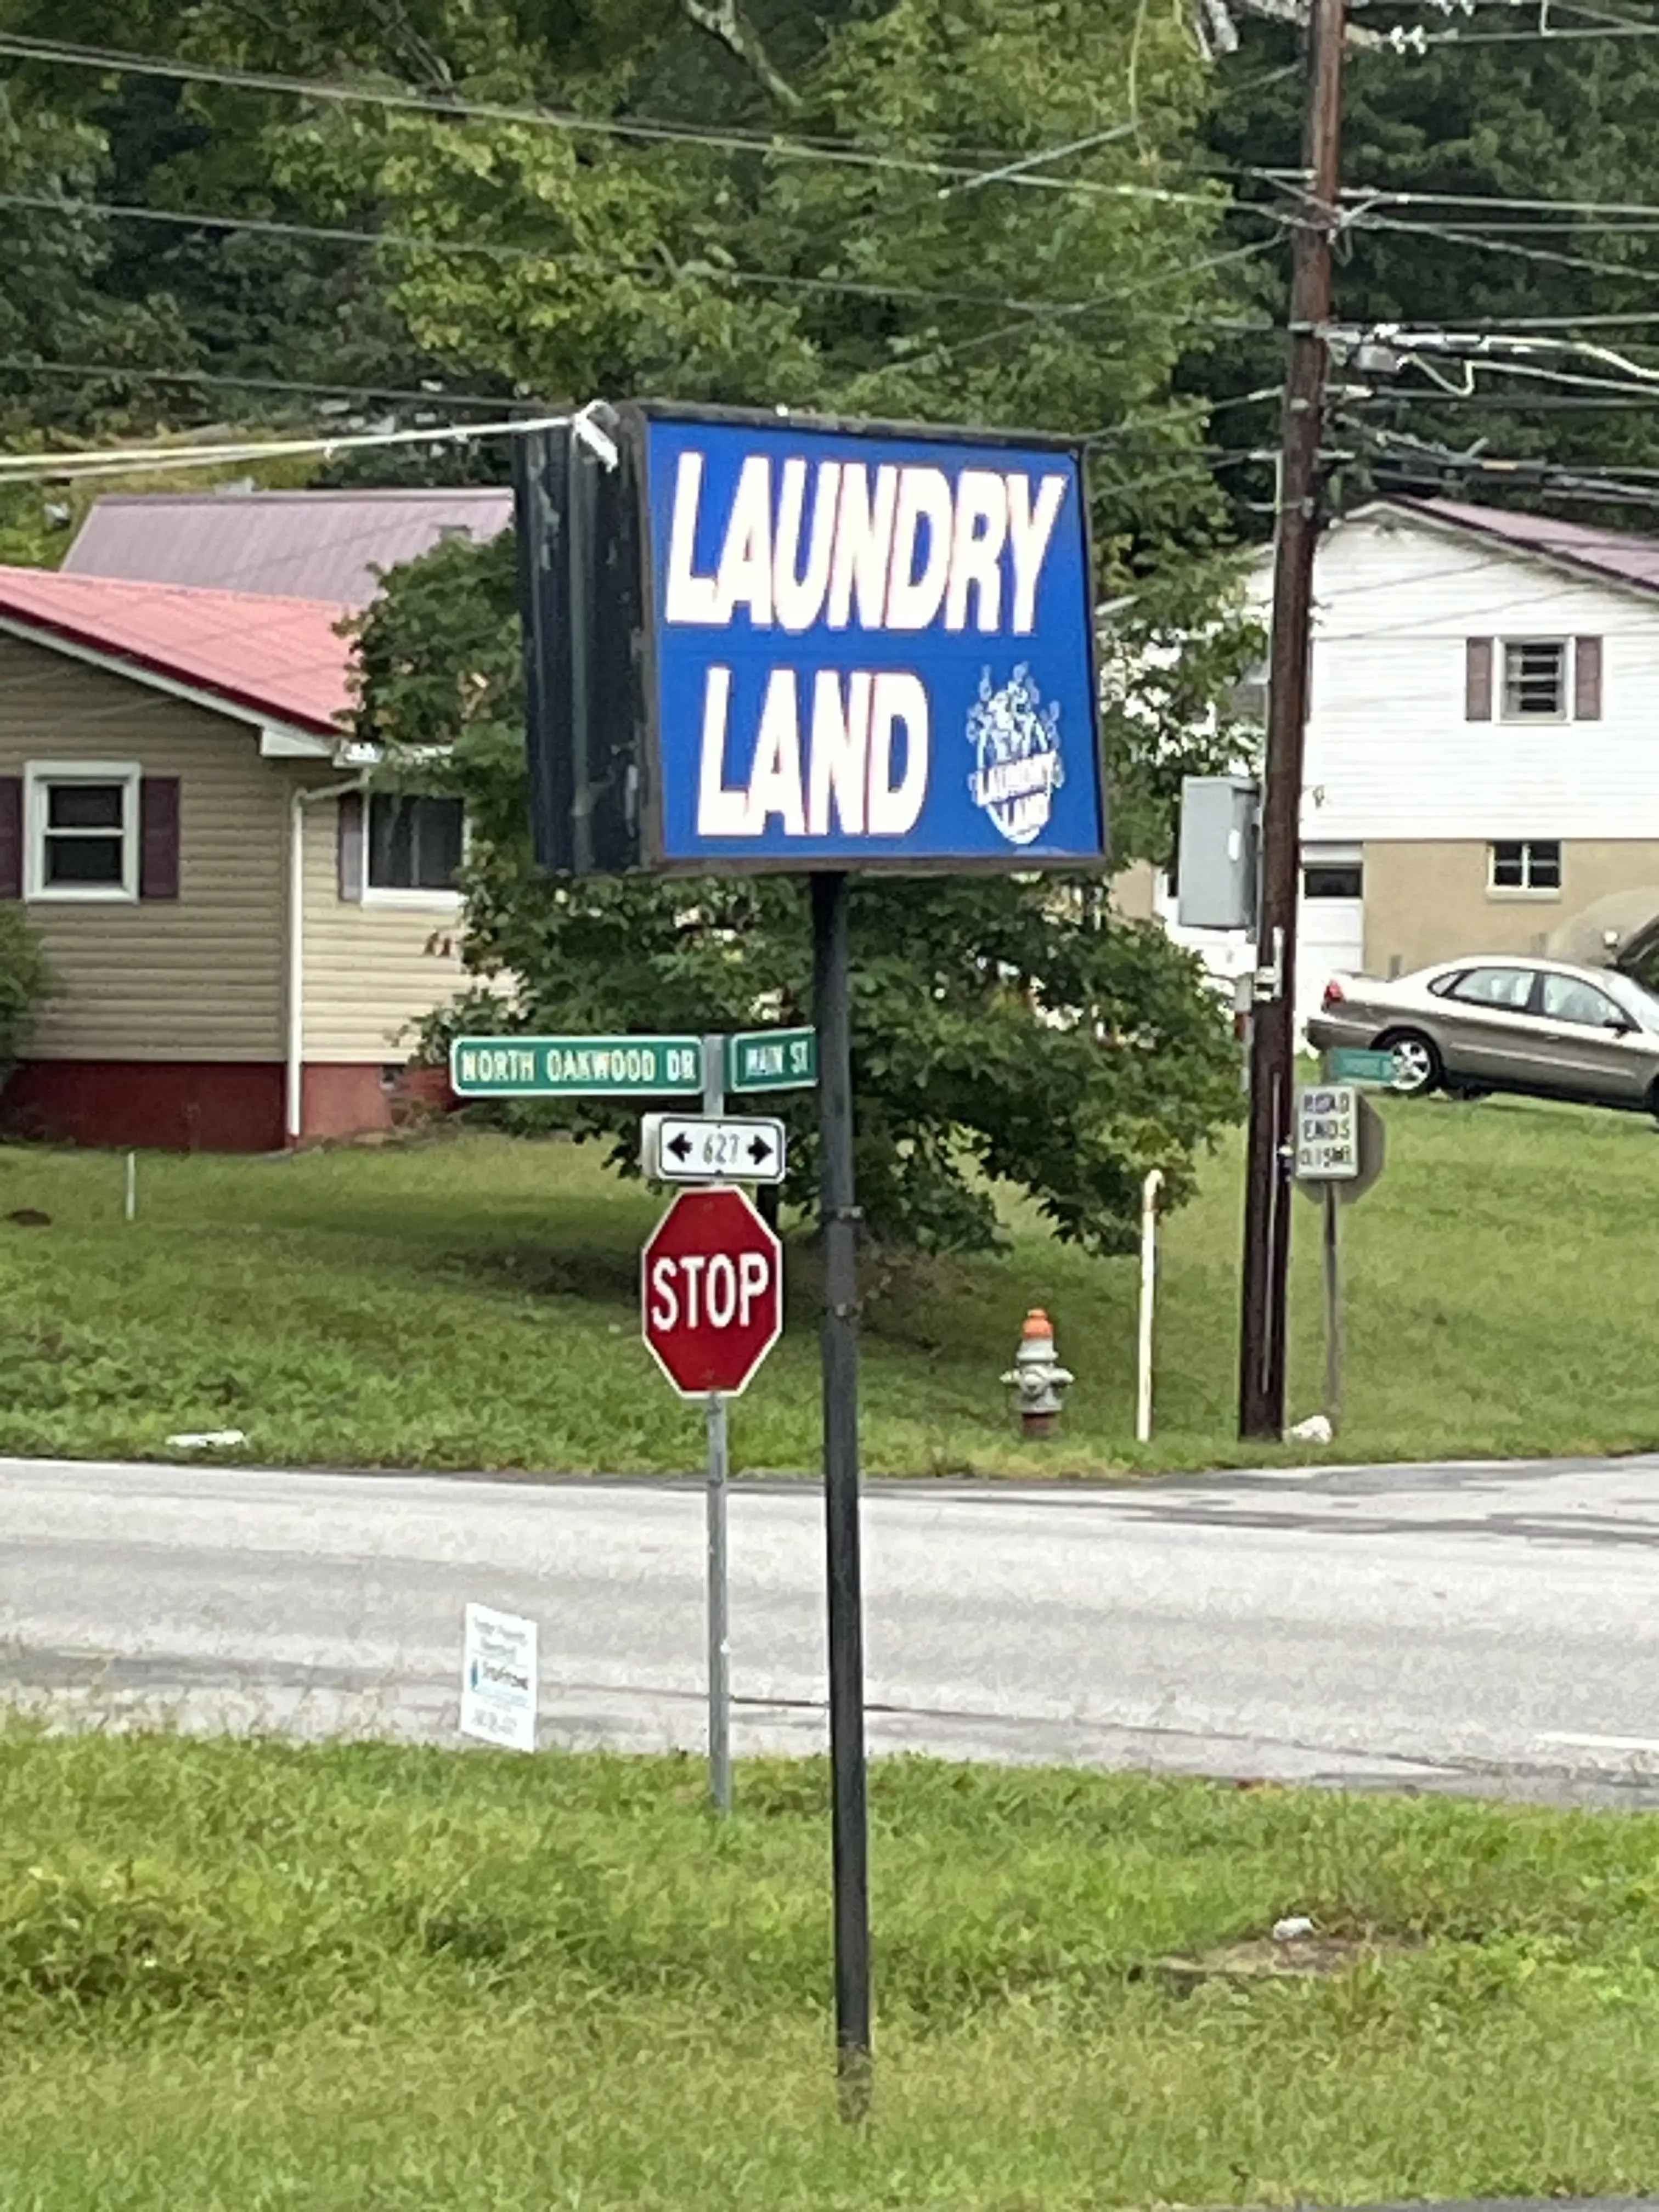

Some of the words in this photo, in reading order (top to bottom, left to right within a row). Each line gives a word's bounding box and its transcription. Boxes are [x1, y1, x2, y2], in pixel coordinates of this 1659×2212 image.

[665, 450, 1069, 635] LAUNDRY
[697, 665, 929, 836] LAND
[462, 1049, 535, 1081] NORTH
[547, 1049, 656, 1081] OAKWOOD
[666, 1049, 696, 1081] DR
[702, 1133, 740, 1164] 627
[652, 1252, 769, 1331] STOP
